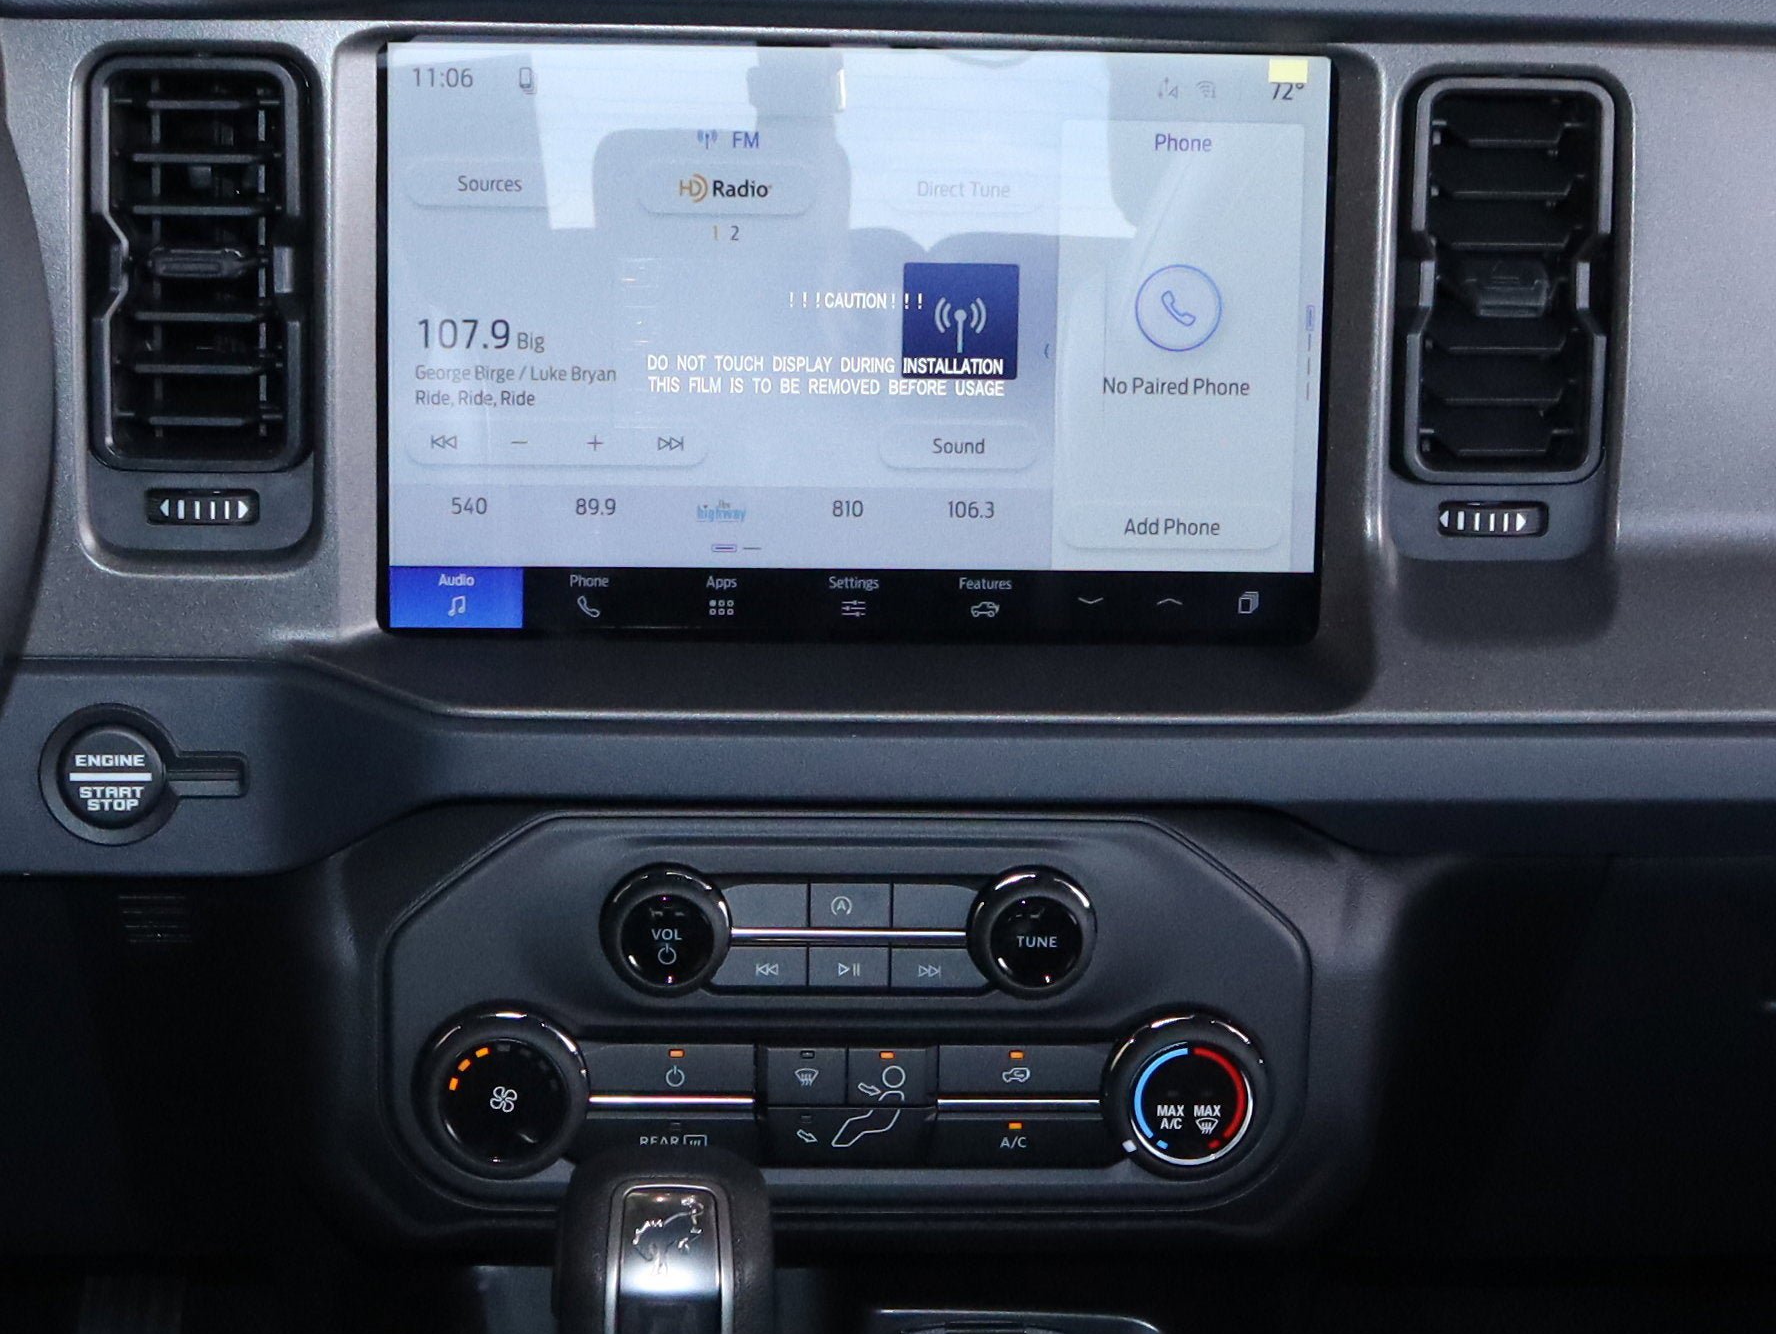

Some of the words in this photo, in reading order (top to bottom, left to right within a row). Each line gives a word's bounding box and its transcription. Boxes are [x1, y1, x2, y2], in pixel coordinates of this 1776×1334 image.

[411, 67, 474, 89] 11:06
[732, 131, 760, 149] FM
[1154, 133, 1213, 153] Phone
[457, 174, 523, 193] Sources
[712, 179, 768, 198] Radio
[917, 181, 965, 198] Direct
[969, 182, 1011, 199] Tune
[712, 226, 719, 241] 1
[730, 226, 740, 242] 2
[418, 318, 511, 350] 107.9
[517, 332, 545, 353] Big
[647, 355, 669, 371] DO
[677, 355, 707, 372] NOT
[714, 355, 764, 372] TOUCH
[772, 357, 833, 373] DISPLAY
[840, 357, 895, 373] DURING
[903, 358, 1004, 375] INSTALLATION
[415, 364, 472, 383] George
[474, 365, 516, 384] Birge
[530, 366, 567, 382] Luke
[570, 366, 617, 384] Bryan
[648, 376, 680, 393] THIS
[688, 377, 722, 394] FILM
[729, 378, 744, 394] IS
[752, 378, 772, 394] TO
[780, 378, 800, 395] BE
[808, 378, 880, 395] REMOVED
[888, 379, 947, 396] BEFORE
[955, 380, 1005, 397] USAGE
[1103, 377, 1128, 395] No
[1132, 377, 1189, 396] Paired
[1192, 378, 1250, 396] Phone
[415, 390, 451, 408] Ride,
[458, 390, 497, 408] Ride,
[500, 390, 536, 407] Ride
[933, 438, 985, 455] Sound
[450, 497, 488, 516] 540
[575, 498, 617, 516] 89.9
[832, 499, 864, 518] 810
[947, 500, 995, 519] 106.3
[1124, 519, 1159, 536] Add
[1163, 519, 1221, 537] Phone
[438, 573, 476, 588] Audio
[569, 574, 610, 588] Phone
[706, 576, 738, 590] Apps
[828, 576, 881, 591] Settings
[959, 577, 1013, 590] Features
[75, 754, 145, 767] ENGINE
[79, 786, 145, 799] START
[87, 798, 139, 812] STOP
[651, 928, 683, 941] VOL
[1016, 936, 1058, 949] TUNE
[1156, 1104, 1185, 1117] MAX
[1193, 1104, 1221, 1117] MAX
[1160, 1117, 1183, 1131] A/C
[999, 1136, 1027, 1149] A/C
